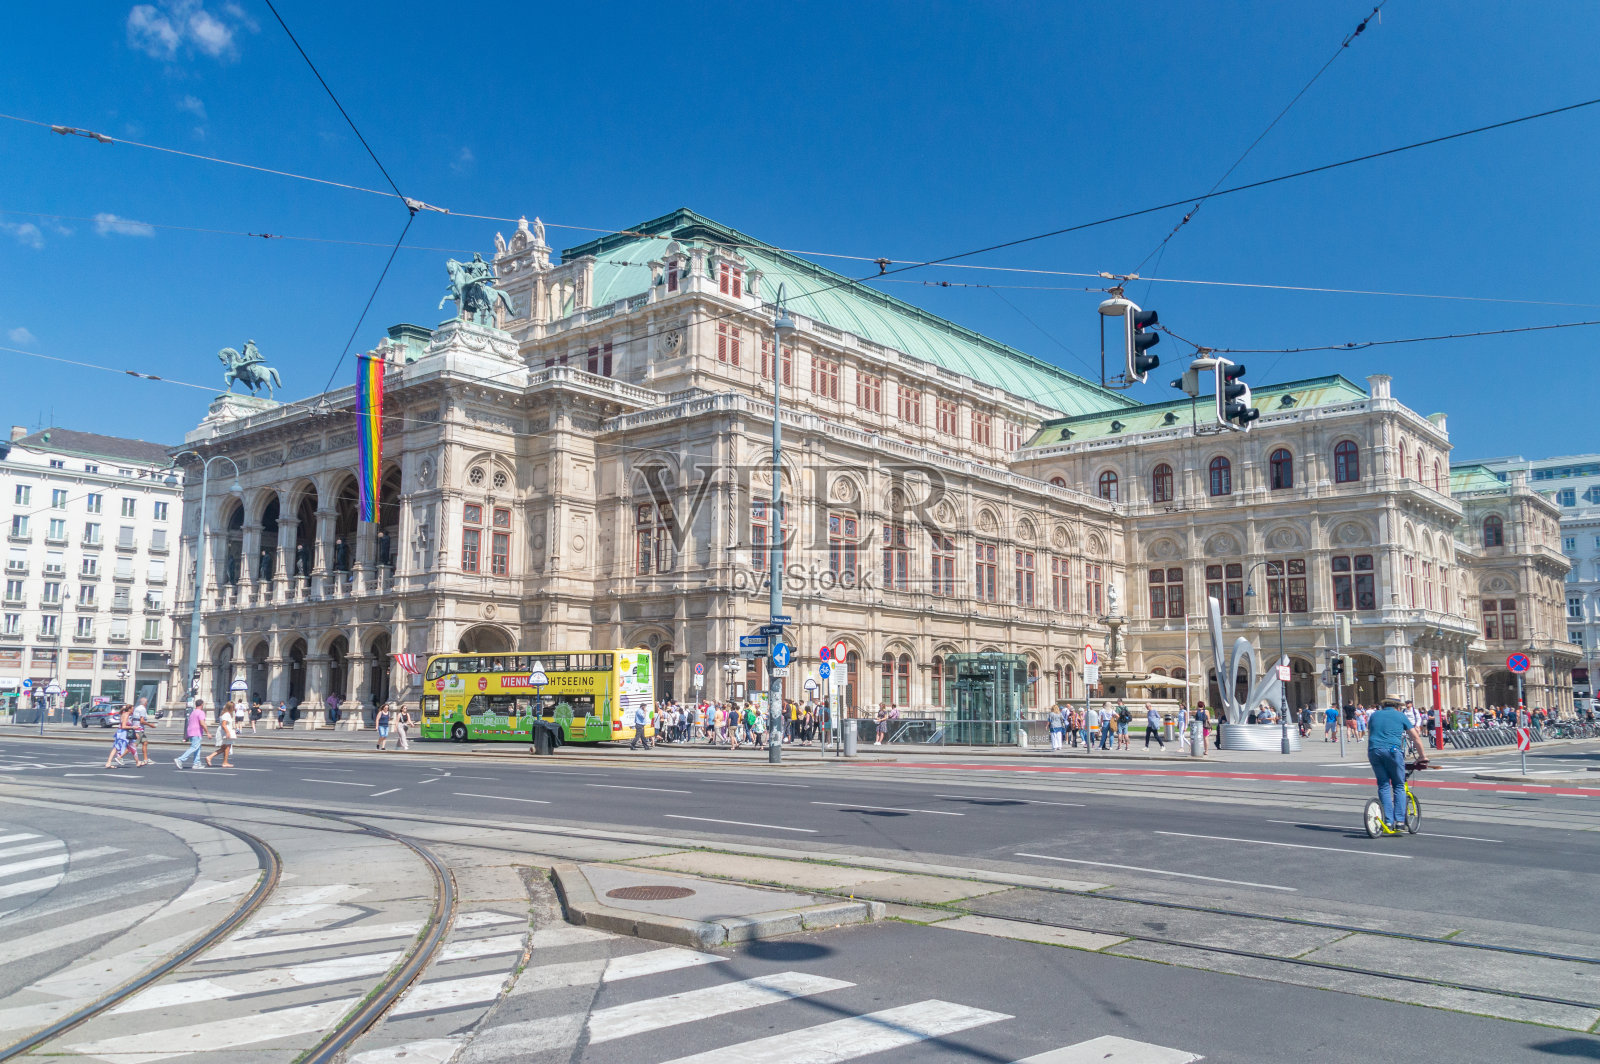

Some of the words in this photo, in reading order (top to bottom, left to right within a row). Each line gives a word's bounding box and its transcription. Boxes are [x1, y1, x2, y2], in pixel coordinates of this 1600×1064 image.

[502, 677, 530, 687] VIENN
[548, 677, 594, 686] HTSEEING
[1028, 735, 1049, 743] ASSAGE
